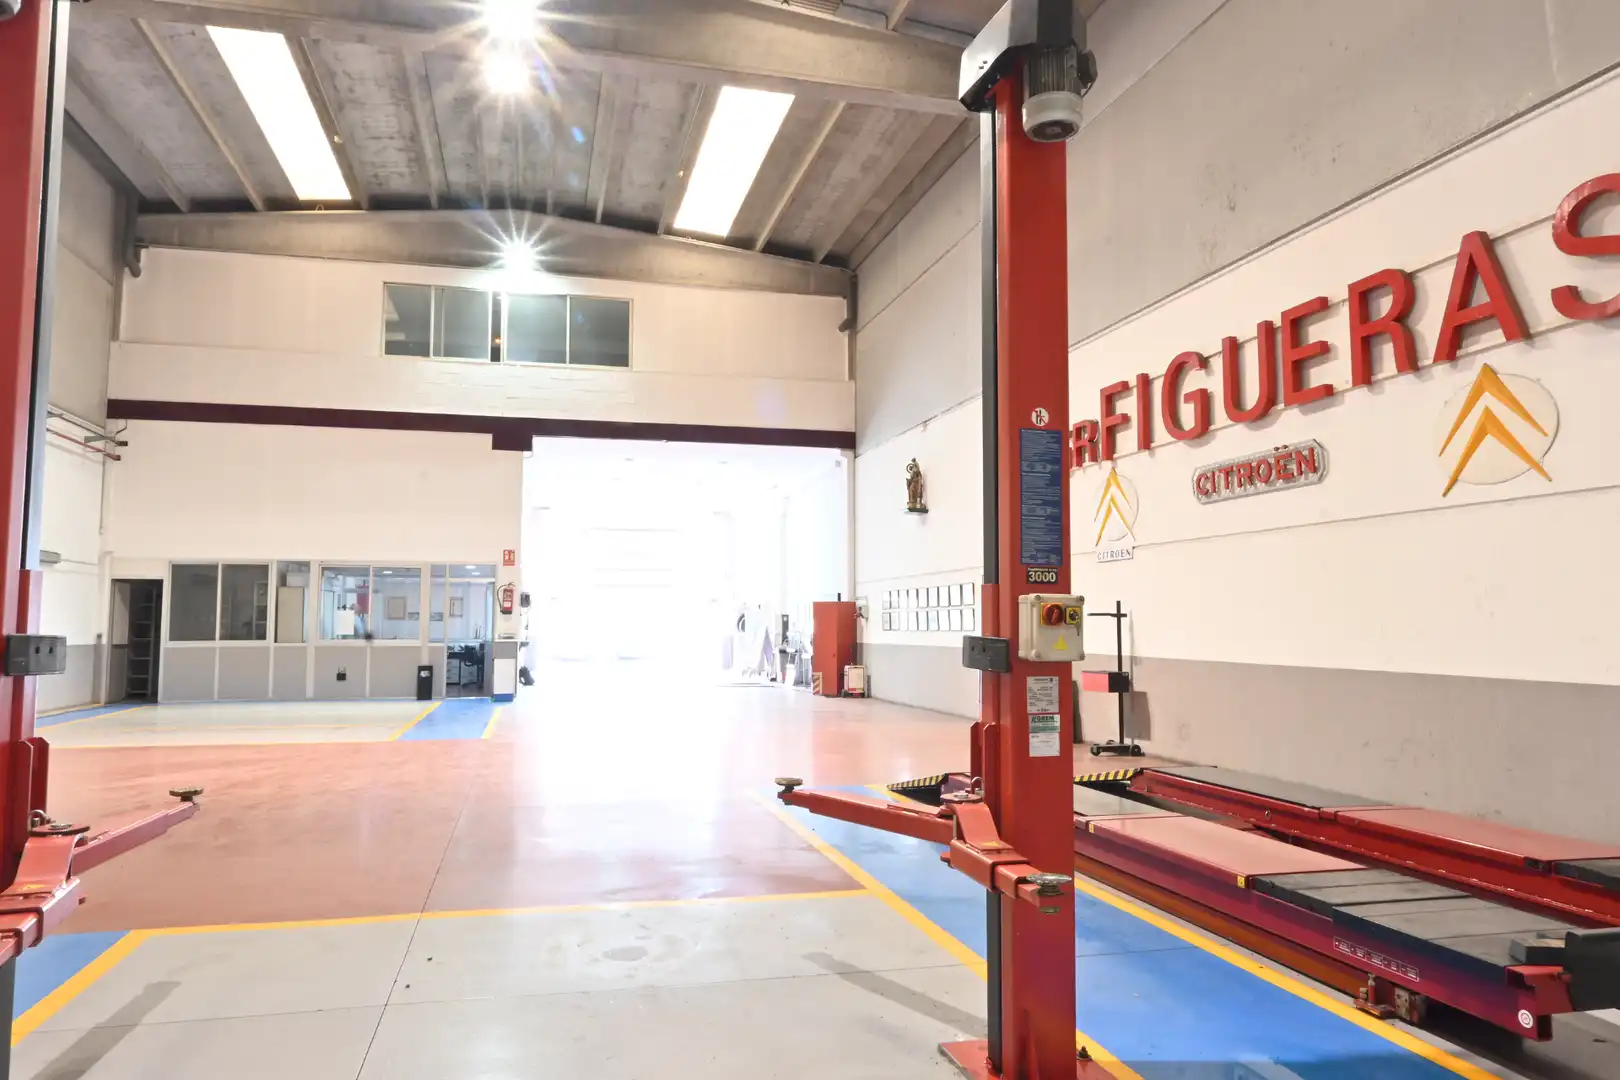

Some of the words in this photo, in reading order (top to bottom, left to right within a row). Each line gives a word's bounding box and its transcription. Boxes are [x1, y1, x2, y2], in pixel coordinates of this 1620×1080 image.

[1100, 172, 1620, 462] FIGUERAS
[1195, 444, 1318, 496] CITROËN
[1028, 571, 1056, 582] 3000
